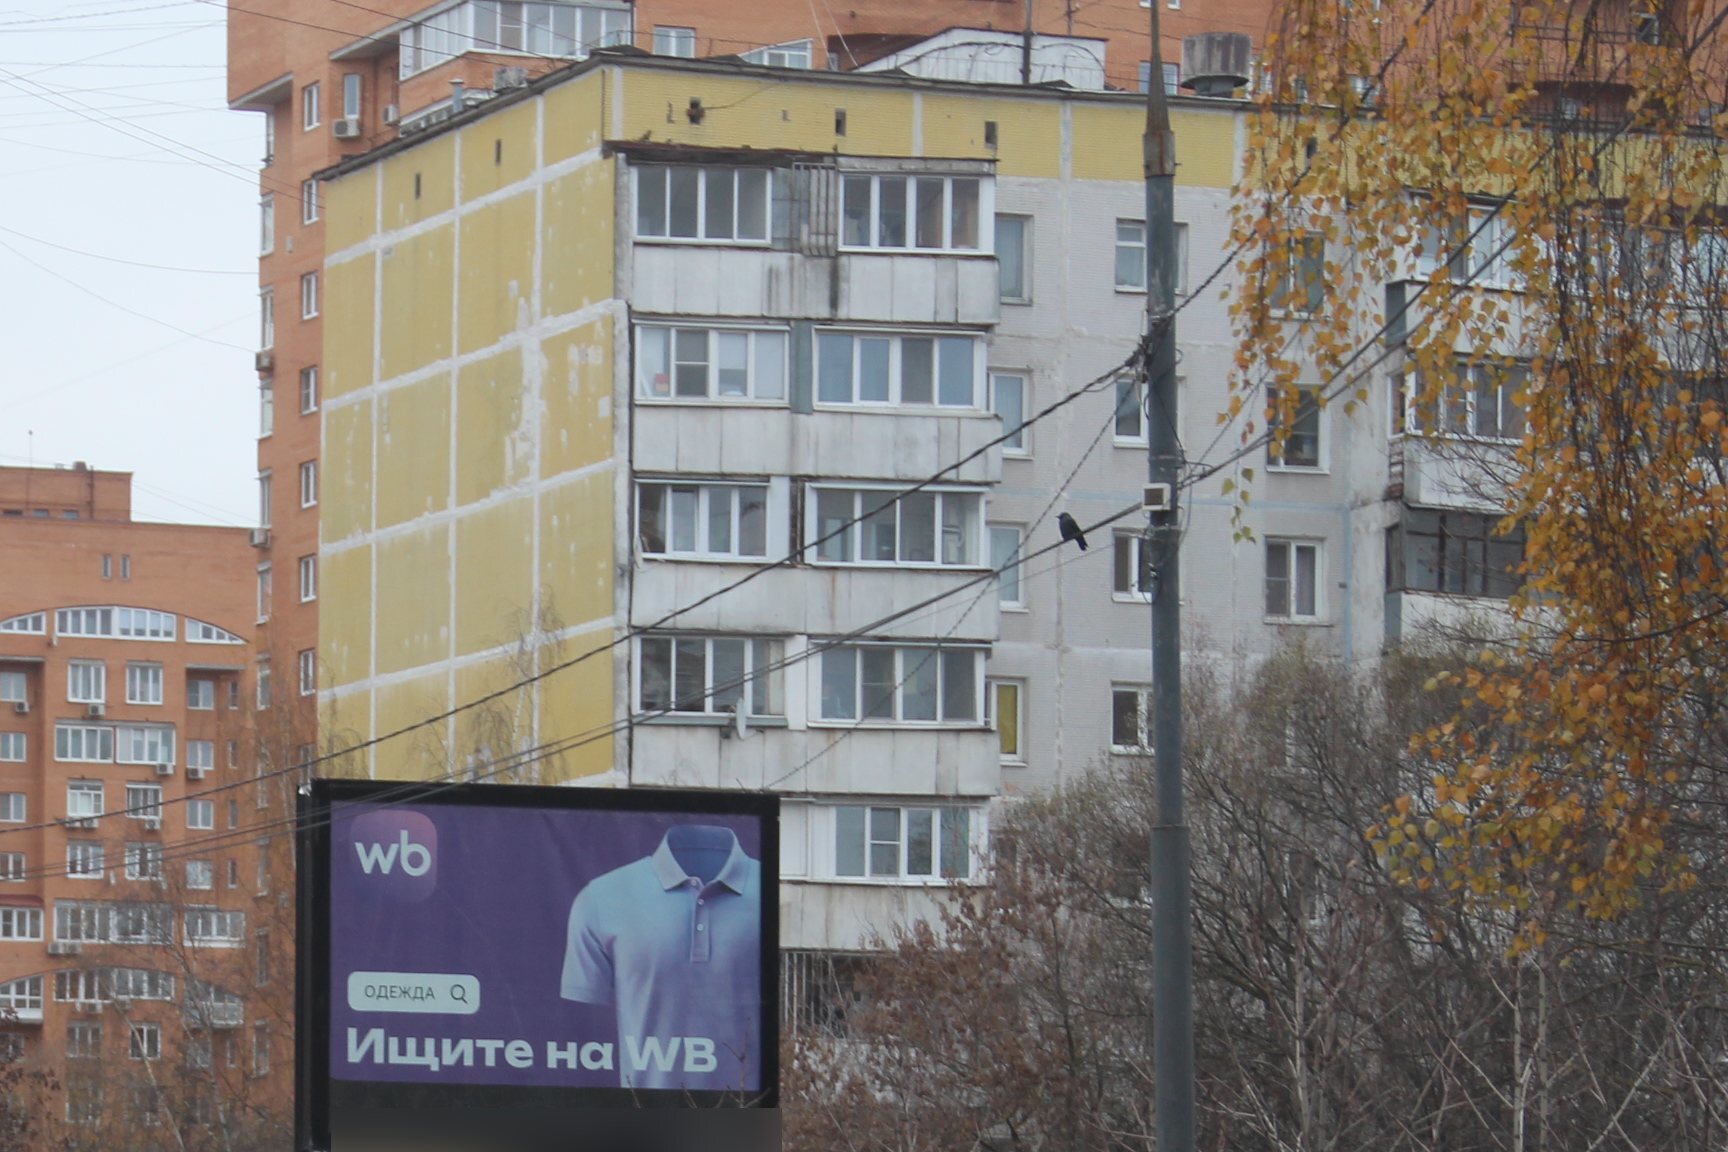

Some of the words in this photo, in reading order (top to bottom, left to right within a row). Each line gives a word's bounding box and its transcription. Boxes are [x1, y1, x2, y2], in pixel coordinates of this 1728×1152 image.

[354, 829, 432, 877] wb
[364, 984, 436, 1002] ОДЕЖДА
[347, 1026, 534, 1072] Ищите
[546, 1040, 614, 1071] на
[625, 1035, 718, 1073] WB
